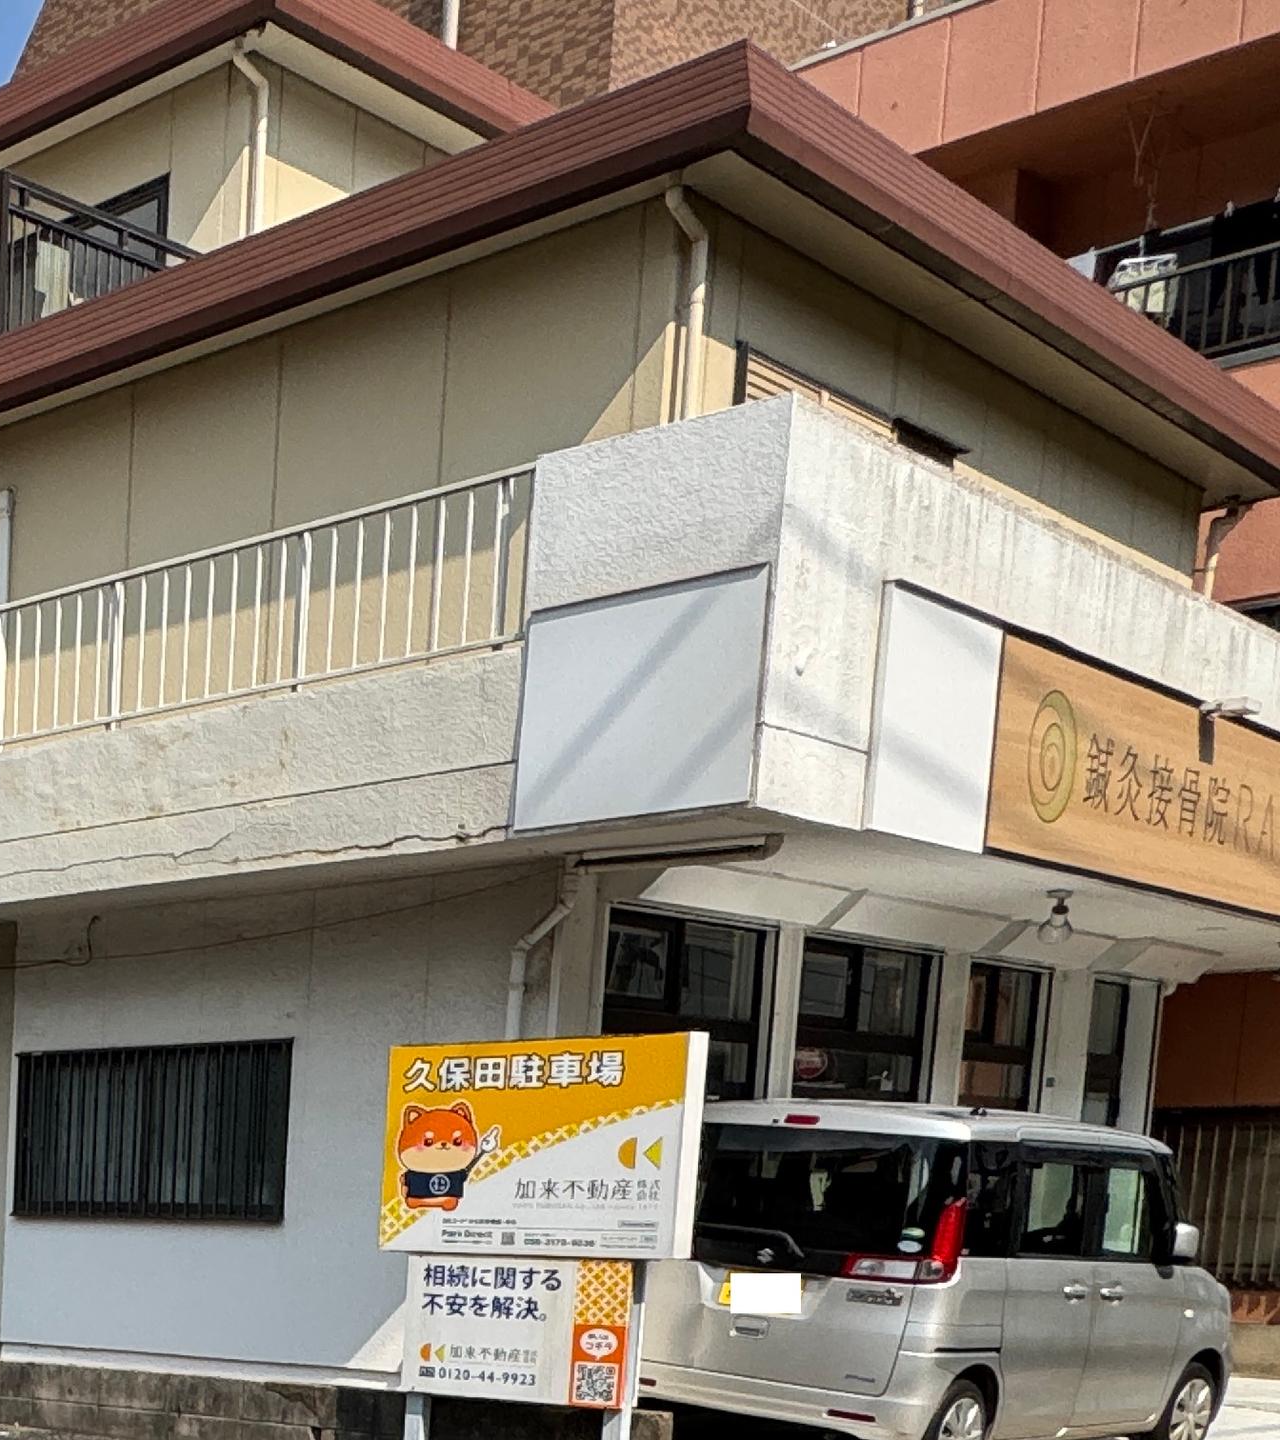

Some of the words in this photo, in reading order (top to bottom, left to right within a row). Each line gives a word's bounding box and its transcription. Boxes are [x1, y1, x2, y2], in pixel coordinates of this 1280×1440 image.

[403, 1051, 624, 1093] 久保田駐車場
[514, 1178, 633, 1201] 加来不動産
[423, 1263, 562, 1291] 相続に関する
[421, 1293, 547, 1321] 不安を解決。
[438, 1366, 537, 1387] 0120-44-9923
